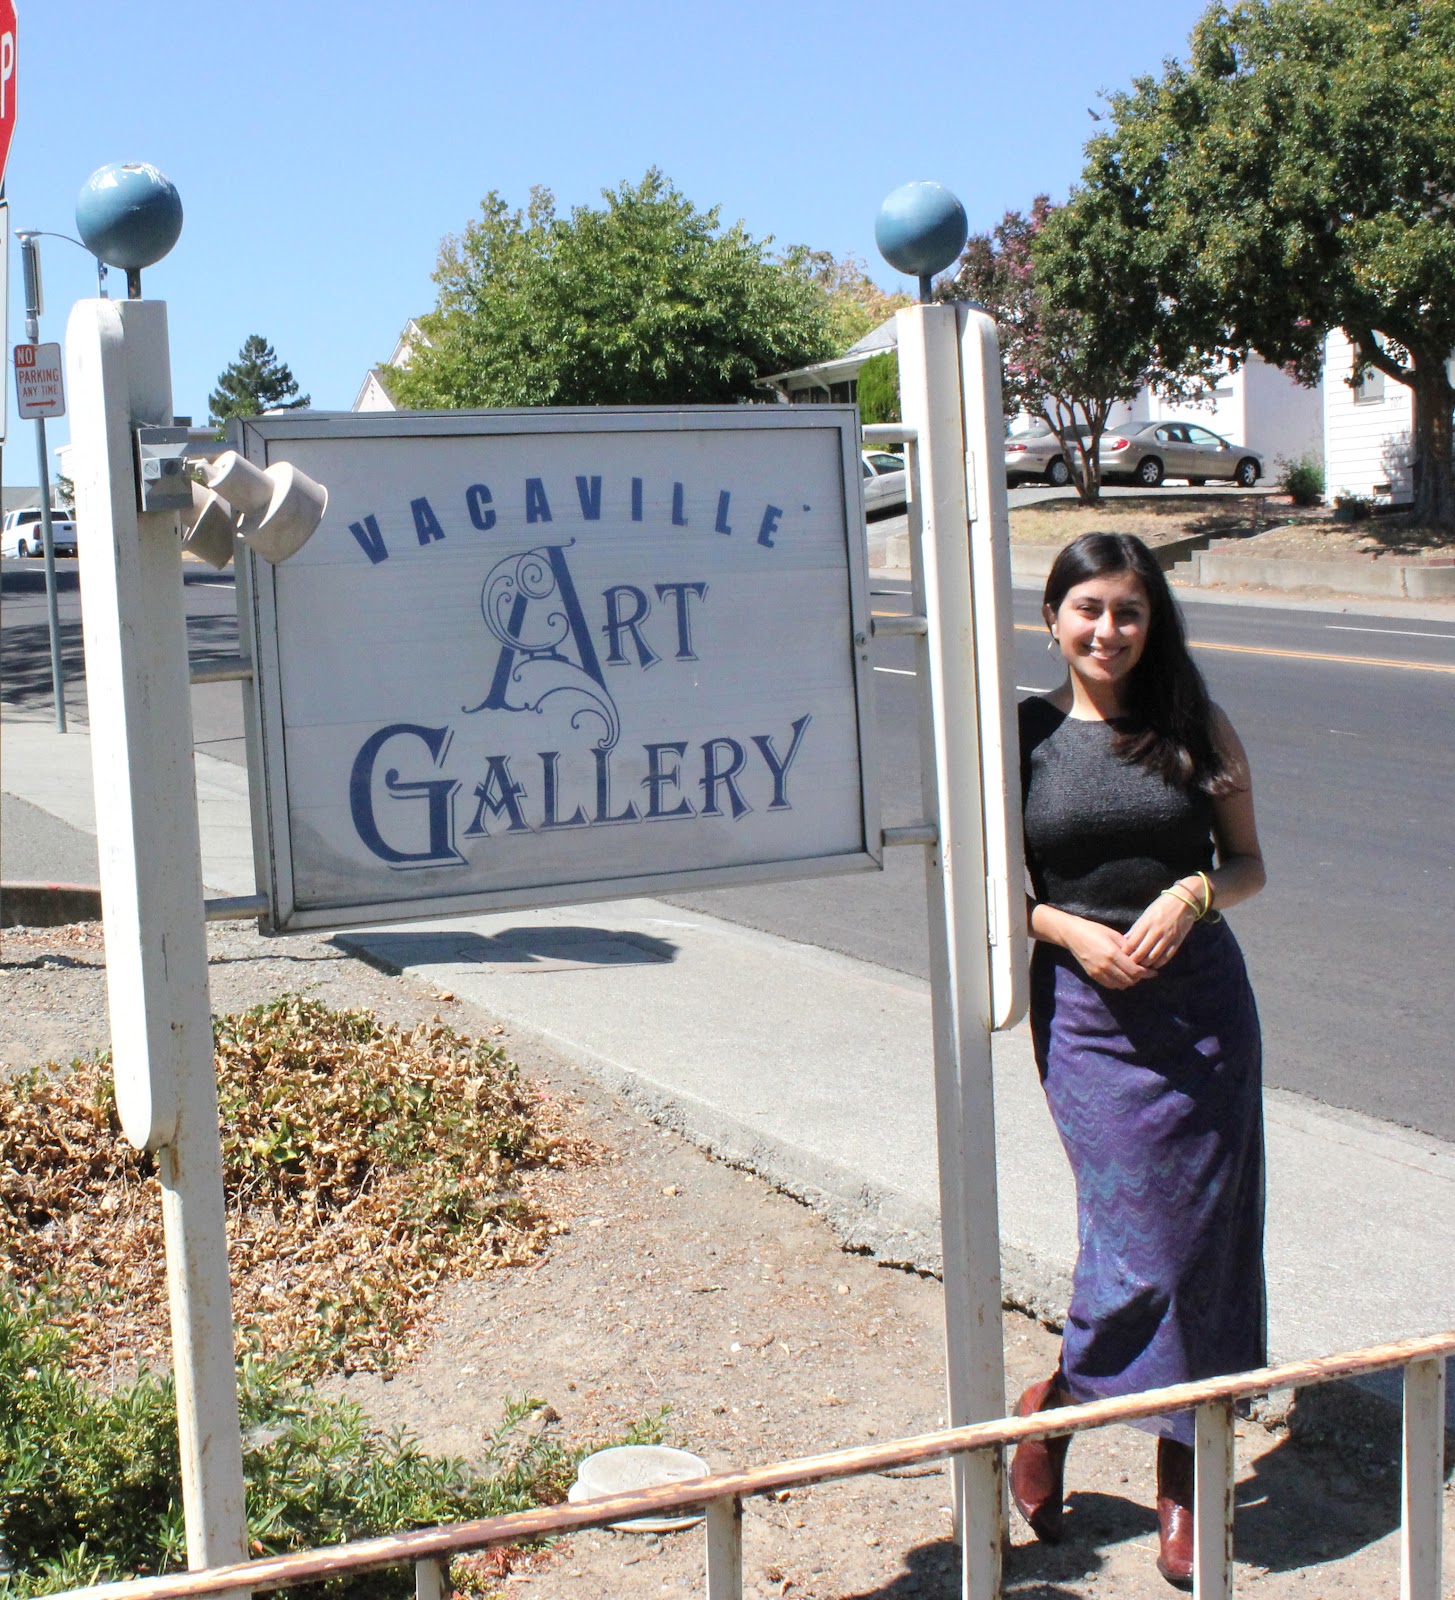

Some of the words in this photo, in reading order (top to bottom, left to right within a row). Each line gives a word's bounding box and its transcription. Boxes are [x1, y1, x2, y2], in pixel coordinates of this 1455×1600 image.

[17, 347, 32, 364] NO
[19, 368, 59, 384] PARKING
[23, 386, 38, 397] ANY
[41, 385, 57, 396] TIME
[348, 475, 784, 565] VACAVILLE
